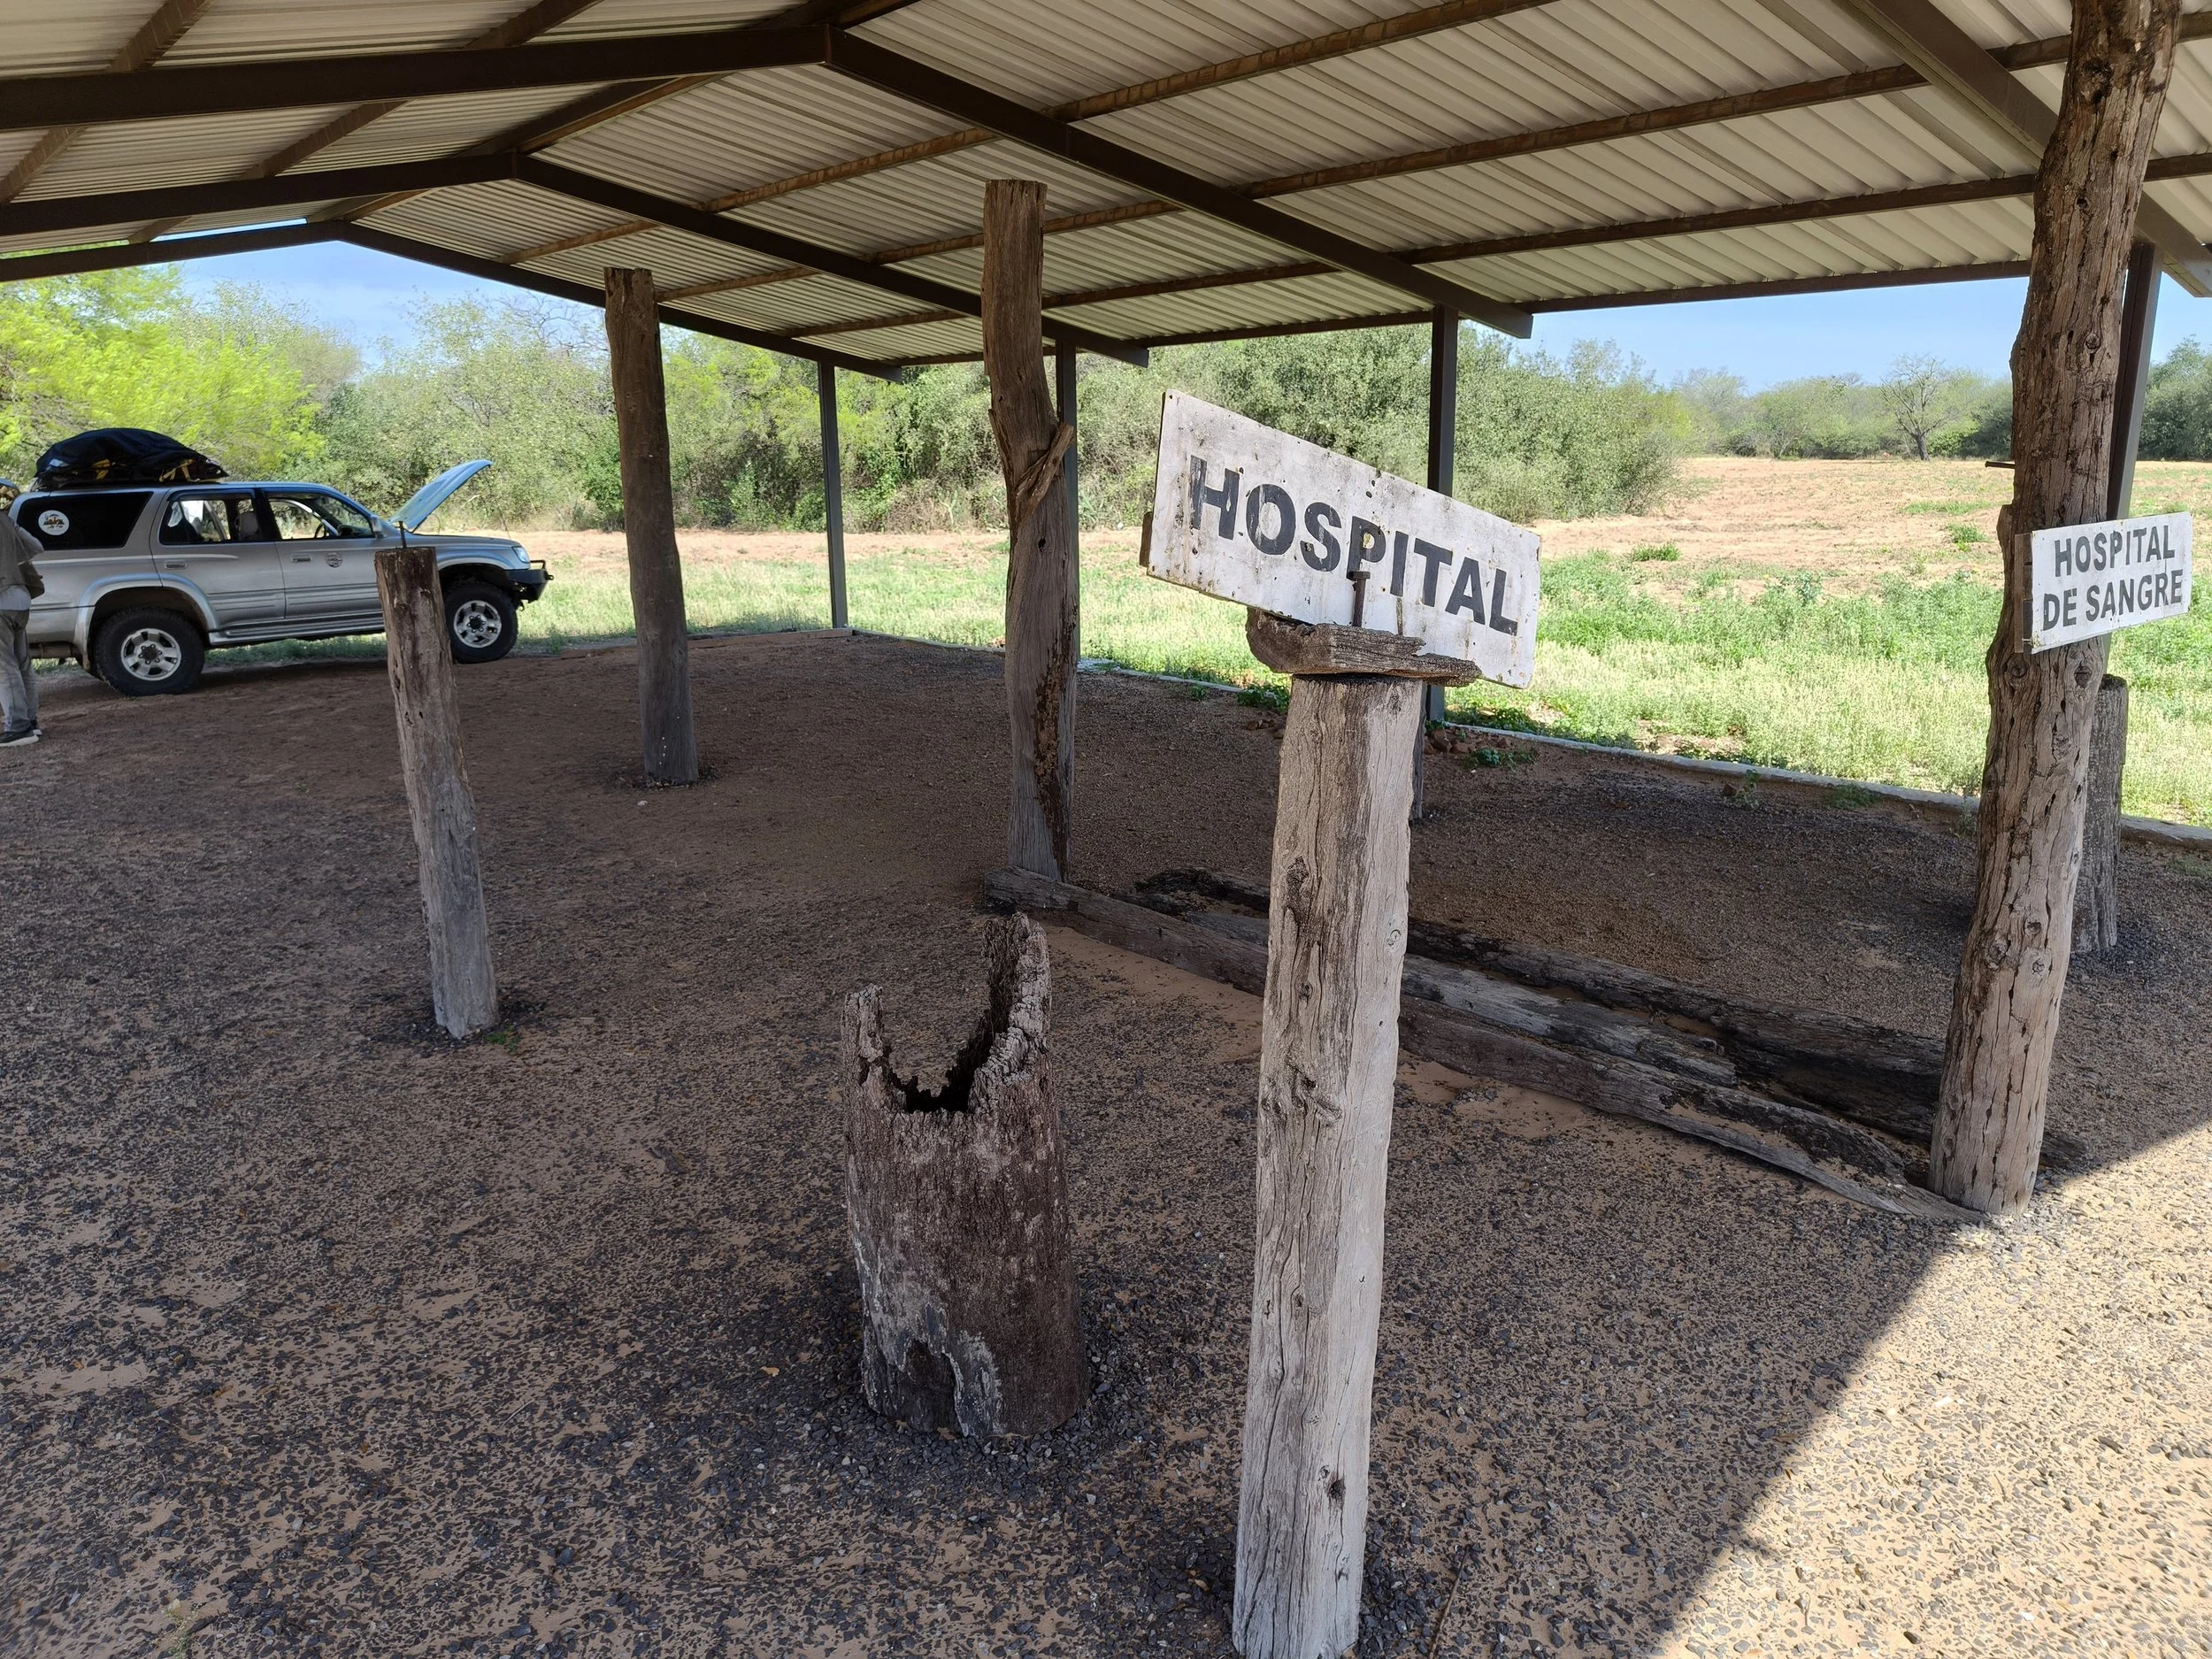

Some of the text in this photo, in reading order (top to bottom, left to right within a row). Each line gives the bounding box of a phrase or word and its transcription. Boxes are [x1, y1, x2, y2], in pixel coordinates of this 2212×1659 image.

[1190, 455, 1518, 636] HOSPITAL
[2055, 525, 2175, 577] HOSPITAL
[2043, 569, 2183, 631] DE SANGRE
